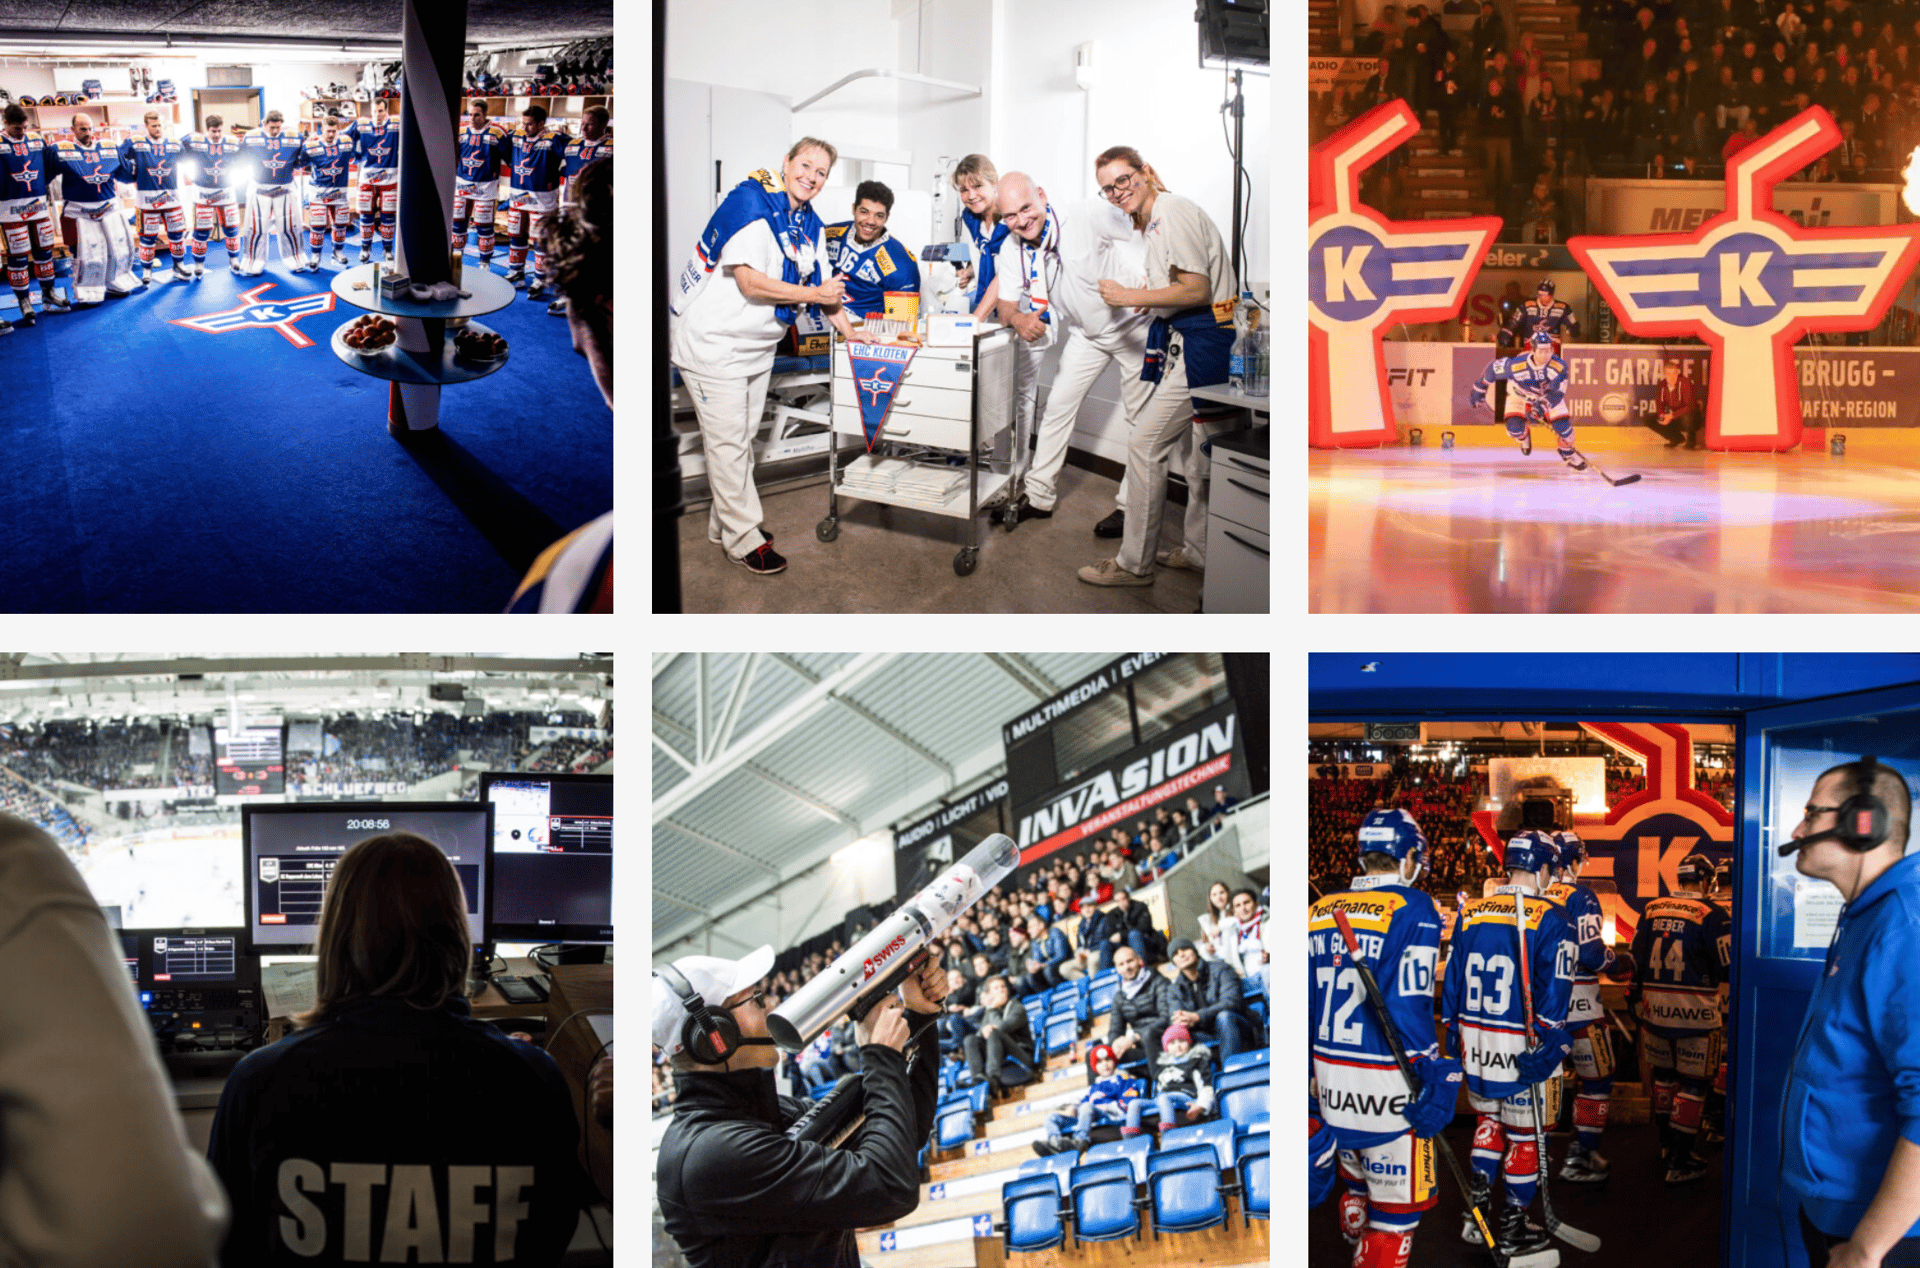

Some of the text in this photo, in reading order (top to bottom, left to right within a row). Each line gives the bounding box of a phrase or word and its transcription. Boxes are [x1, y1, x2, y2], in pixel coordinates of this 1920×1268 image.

[1323, 246, 1378, 303] K
[1719, 250, 1777, 308] K
[853, 344, 908, 360] EHC KLOTEN
[1570, 358, 1599, 385] F.T.
[1605, 358, 1695, 386] GARAE
[1796, 360, 1876, 387] BRUGG
[1570, 399, 1593, 417] IHR
[1802, 401, 1898, 418] AFEN-REGION
[1011, 674, 1110, 740] MULTIMEDIA
[1019, 713, 1236, 850] INVASION
[346, 819, 391, 830] 20:08:56
[898, 819, 935, 850] AUDIO
[941, 796, 978, 827] LICHT
[1652, 918, 1686, 933] BIEBER
[872, 934, 906, 967] SWISS
[1649, 938, 1686, 982] 44
[1316, 966, 1367, 1046] 72
[1464, 952, 1516, 1016] 63
[1653, 1004, 1716, 1021] HUAWEI
[277, 1157, 536, 1264] STAFF
